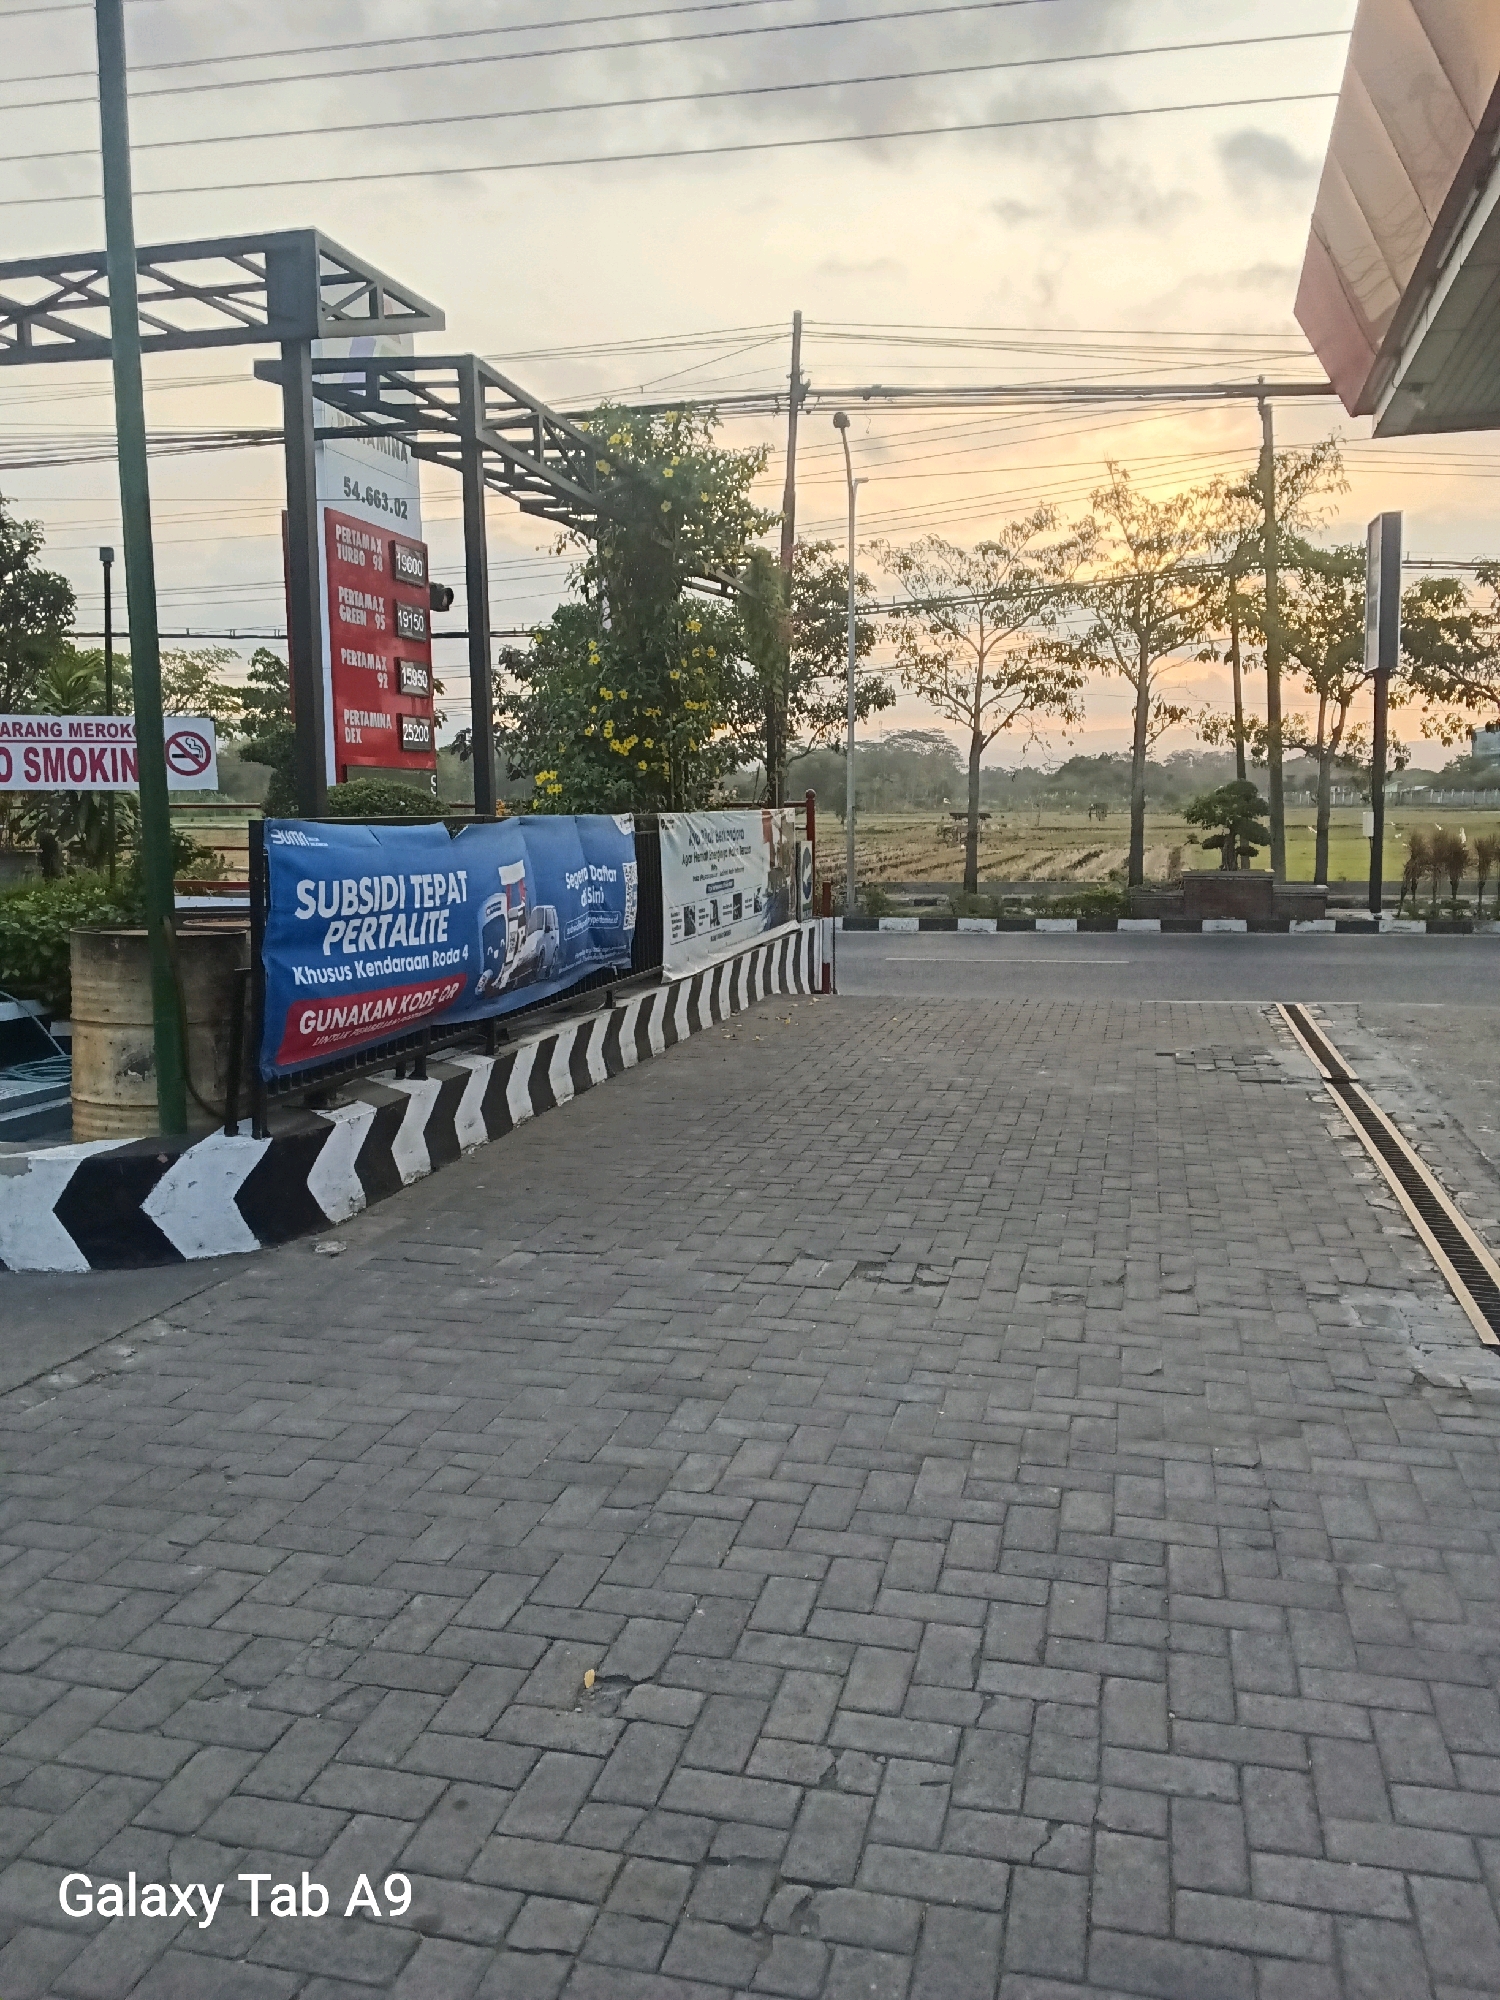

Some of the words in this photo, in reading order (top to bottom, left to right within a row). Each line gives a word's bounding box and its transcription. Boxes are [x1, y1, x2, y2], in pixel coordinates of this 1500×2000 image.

[343, 475, 408, 520] 54.663.02
[335, 523, 383, 555] PERTAMAX
[336, 542, 366, 567] TURBO
[372, 554, 384, 573] 98
[395, 552, 423, 577] 19600
[338, 585, 385, 614] PERTAMAX
[339, 603, 367, 627] GREEN
[374, 613, 386, 631] 95
[397, 609, 425, 632] 19150
[340, 647, 388, 672] PERTAMAX
[376, 672, 389, 689] 92
[401, 666, 428, 689] 15950
[0, 721, 63, 738] ARANG
[343, 708, 393, 730] PERTAMINA
[402, 723, 430, 742] 25200
[344, 726, 363, 744] DEX
[23, 746, 140, 783] SMOKIN
[565, 866, 589, 890] Segera
[588, 864, 617, 882] Daftar
[294, 875, 406, 920] SUBSIDI
[409, 870, 467, 909] TEPAT
[322, 908, 450, 956] PERTALITE
[292, 964, 353, 986] Khusus
[354, 953, 430, 979] Kendaraan
[432, 948, 461, 968] Roda
[462, 944, 469, 961] 4
[299, 996, 399, 1035] GUNAKAN
[398, 987, 440, 1015] KODE
[438, 982, 461, 1003] QR
